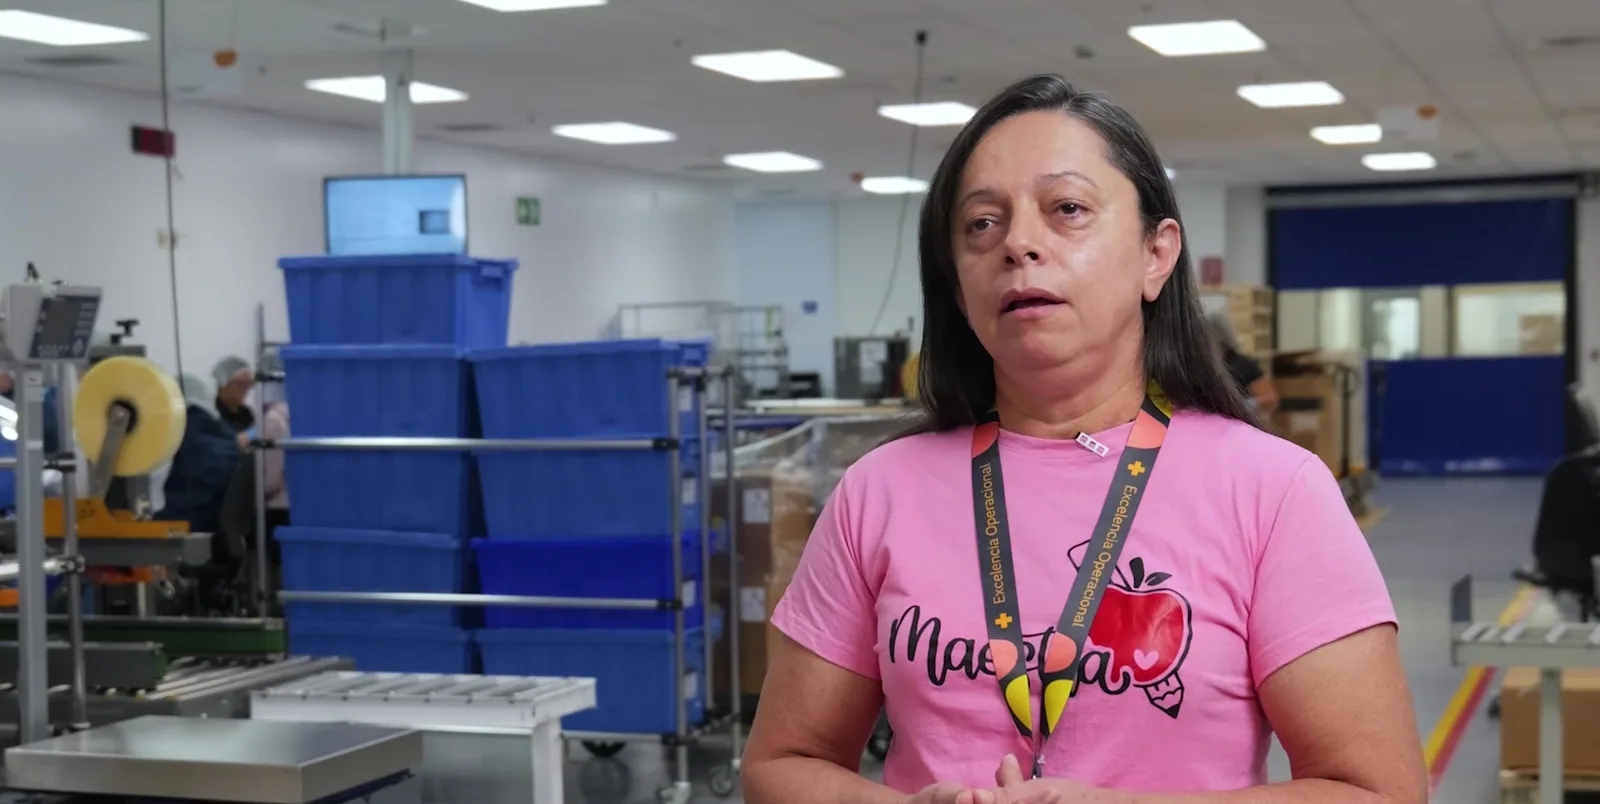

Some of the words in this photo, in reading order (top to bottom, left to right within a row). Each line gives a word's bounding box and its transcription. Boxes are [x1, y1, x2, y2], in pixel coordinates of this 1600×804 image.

[979, 462, 1000, 536] Operacional
[1102, 484, 1137, 550] Excelencia
[988, 538, 1006, 605] Excelencia
[1072, 551, 1111, 628] Operacional
[888, 605, 1131, 697] Maeta
